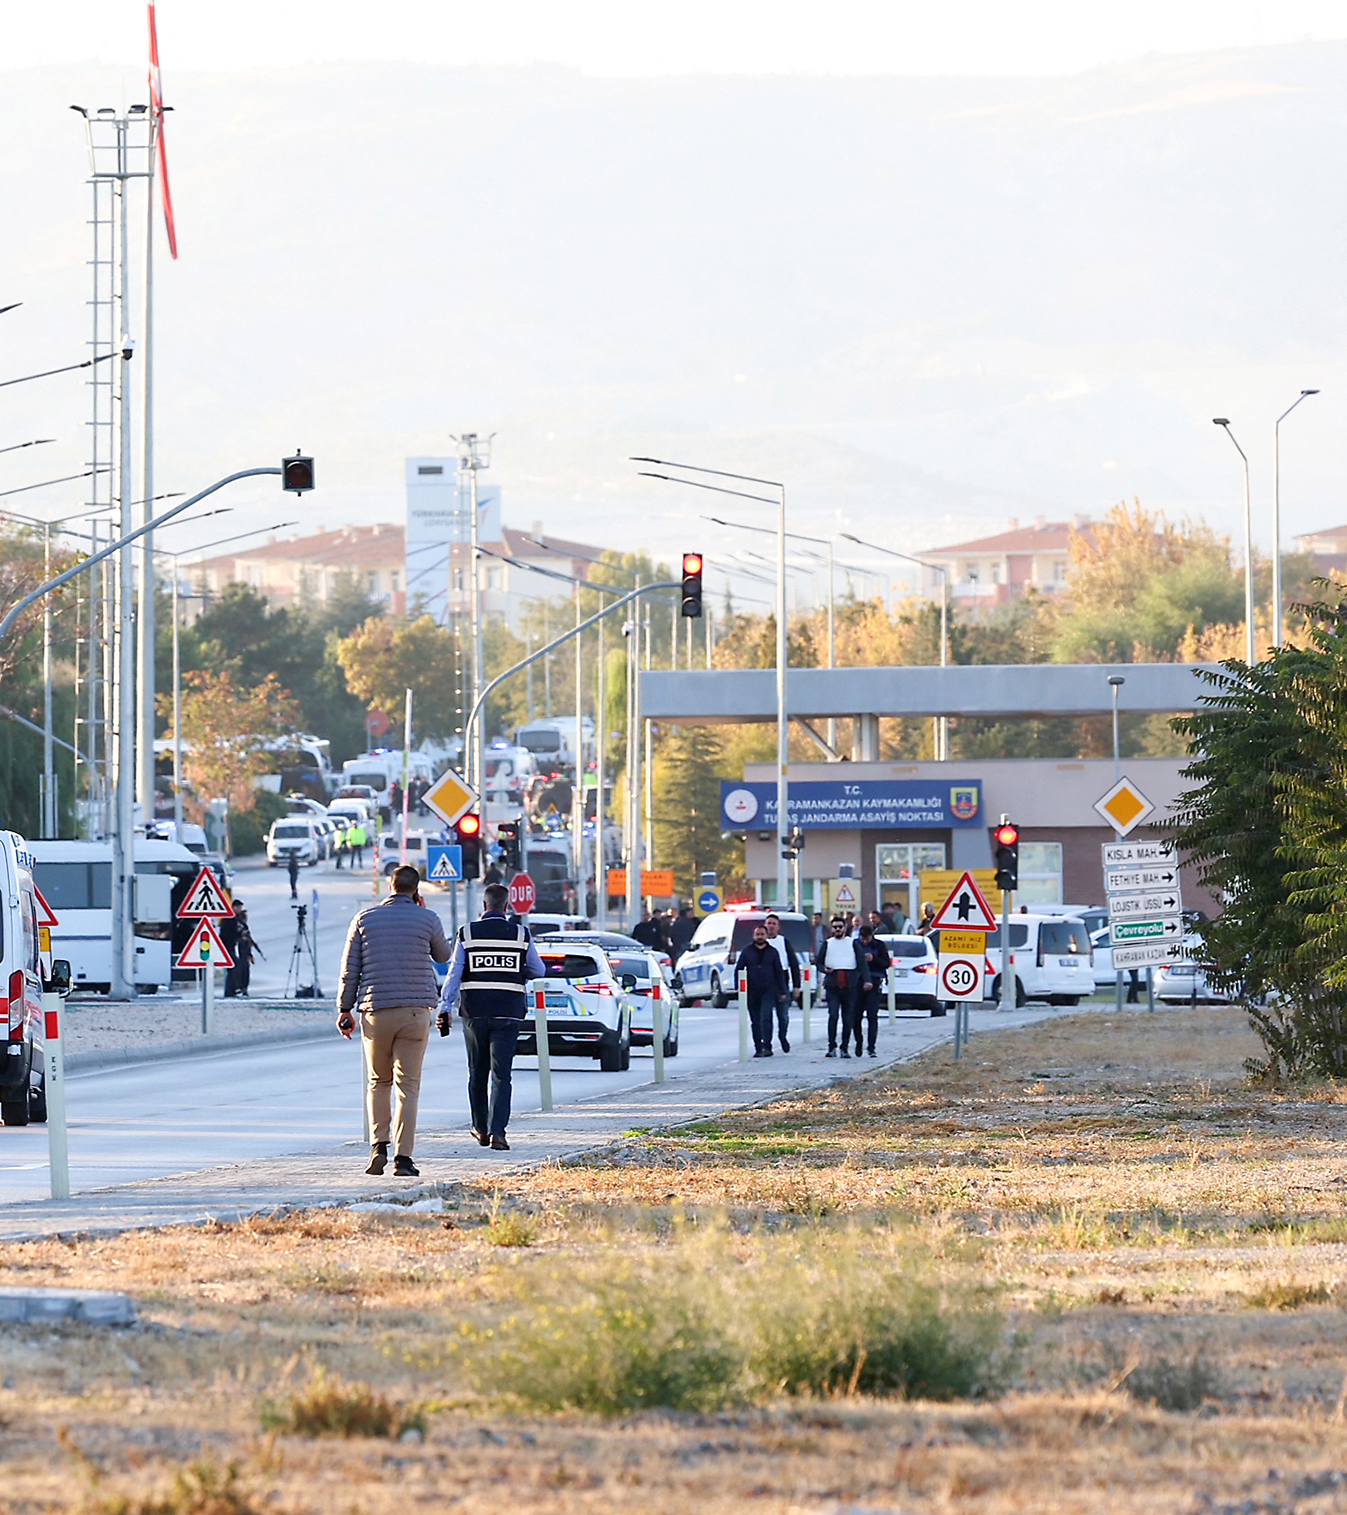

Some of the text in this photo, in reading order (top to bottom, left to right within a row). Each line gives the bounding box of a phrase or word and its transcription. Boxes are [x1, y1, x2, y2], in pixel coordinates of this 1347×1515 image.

[843, 785, 863, 795] T.C.
[766, 799, 860, 810] KARAMANKAZAN
[764, 813, 798, 825] TUAŞ
[801, 812, 858, 823] JANDARMA
[898, 811, 944, 822] NOKTASI
[511, 885, 533, 902] DUR
[1116, 923, 1163, 937] Çevreyolu
[950, 970, 971, 985] 30
